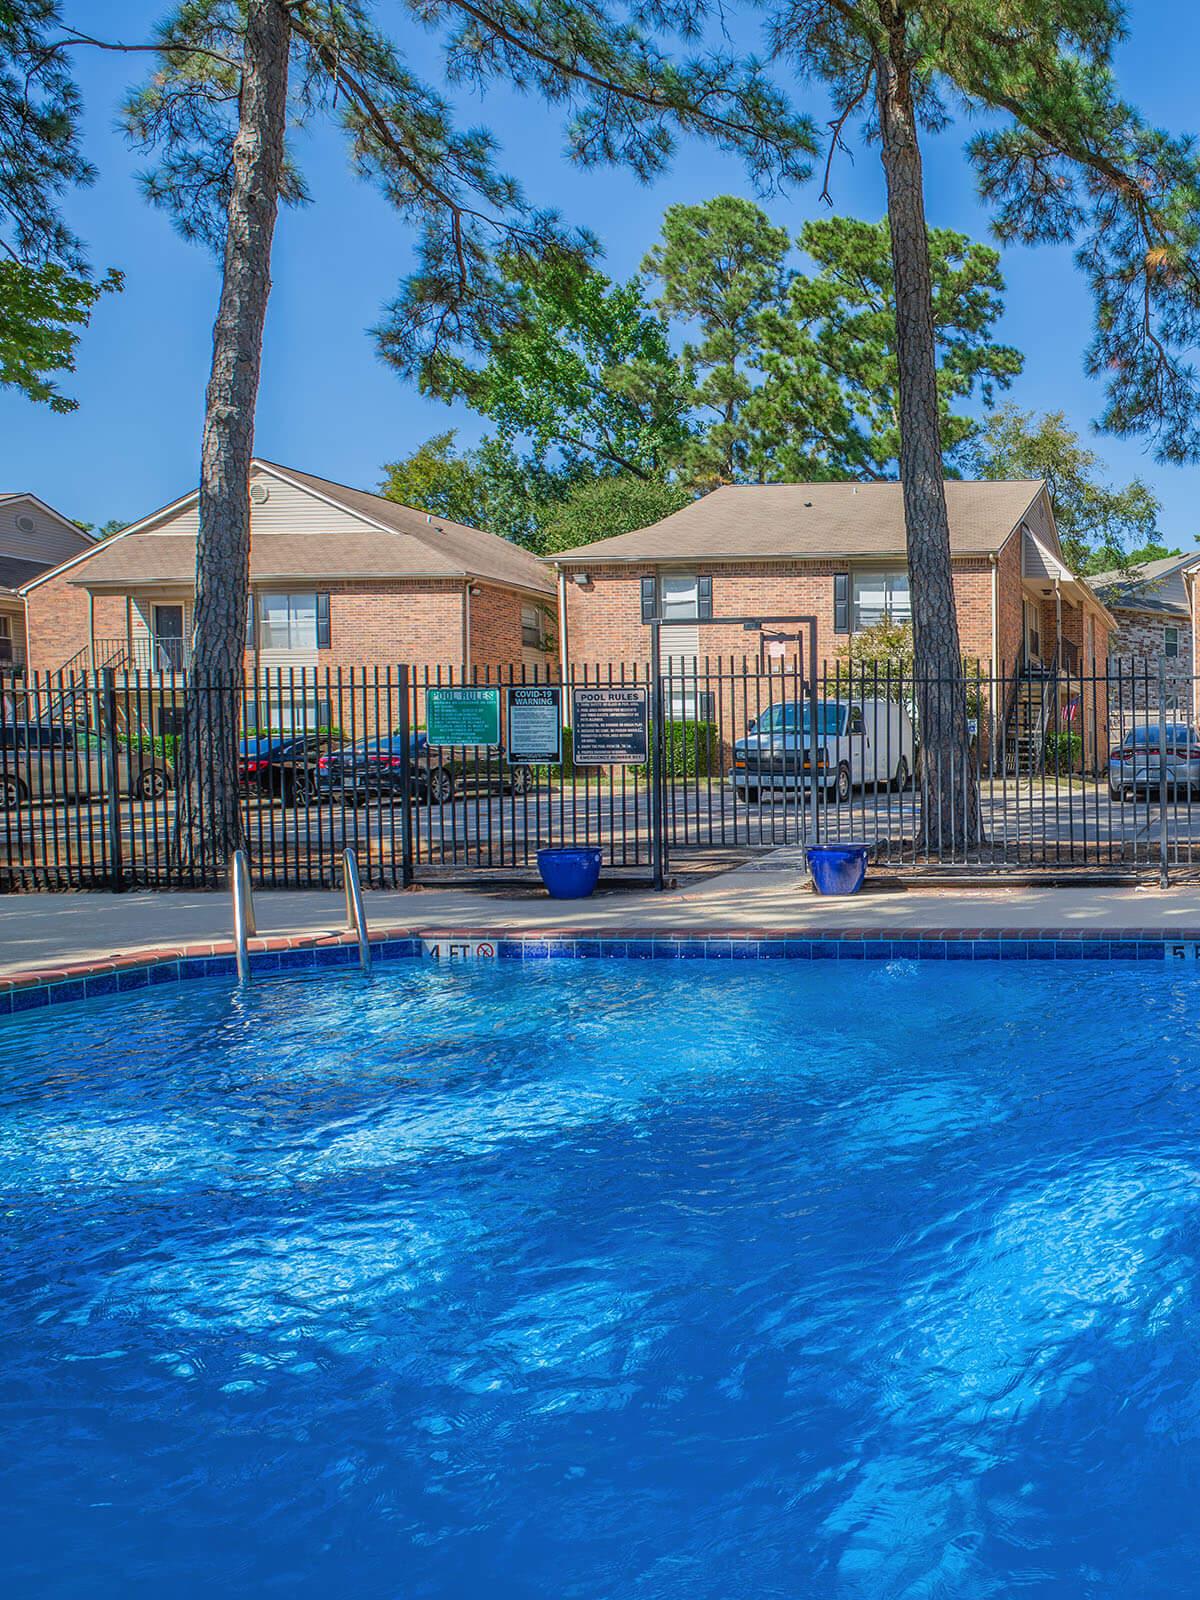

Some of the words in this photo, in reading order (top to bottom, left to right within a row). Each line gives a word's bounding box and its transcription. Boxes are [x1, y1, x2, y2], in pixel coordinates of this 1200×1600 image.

[515, 690, 552, 698] COVID-19
[608, 693, 640, 701] RULES
[430, 943, 440, 958] 4
[449, 944, 471, 958] FT
[1172, 945, 1186, 960] 5
